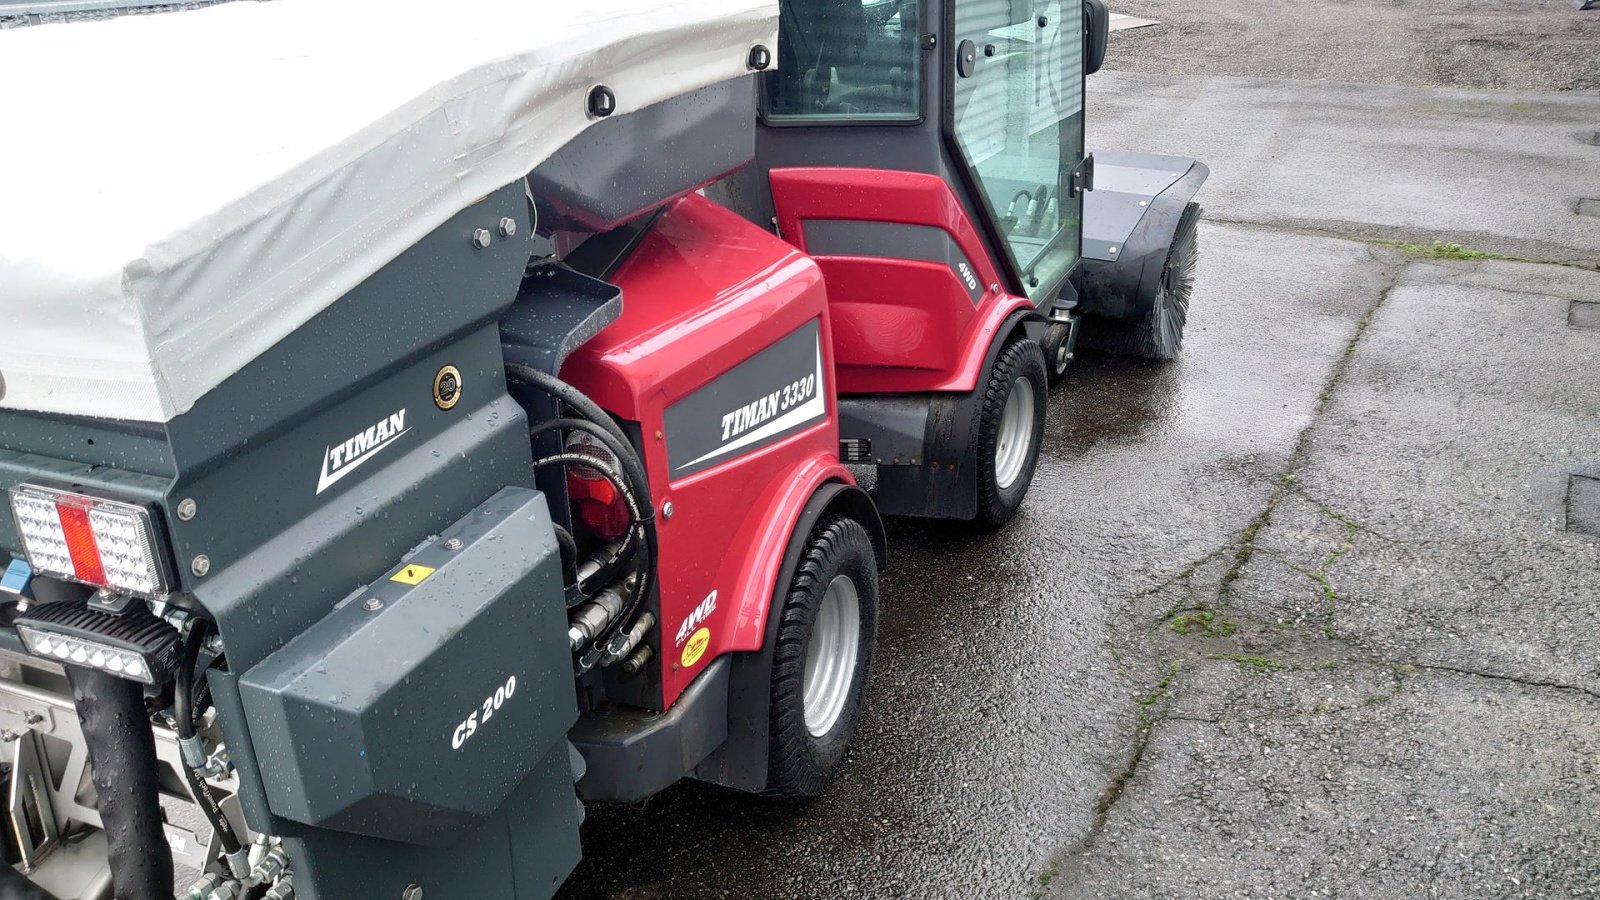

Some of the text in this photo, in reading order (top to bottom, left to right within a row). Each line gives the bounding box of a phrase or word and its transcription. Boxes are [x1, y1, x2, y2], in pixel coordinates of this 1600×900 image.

[958, 263, 976, 290] 4WD
[722, 373, 814, 441] TIMAN 3330
[330, 408, 406, 470] TIMAN
[675, 589, 718, 642] 4WD
[452, 675, 516, 750] CS 200
